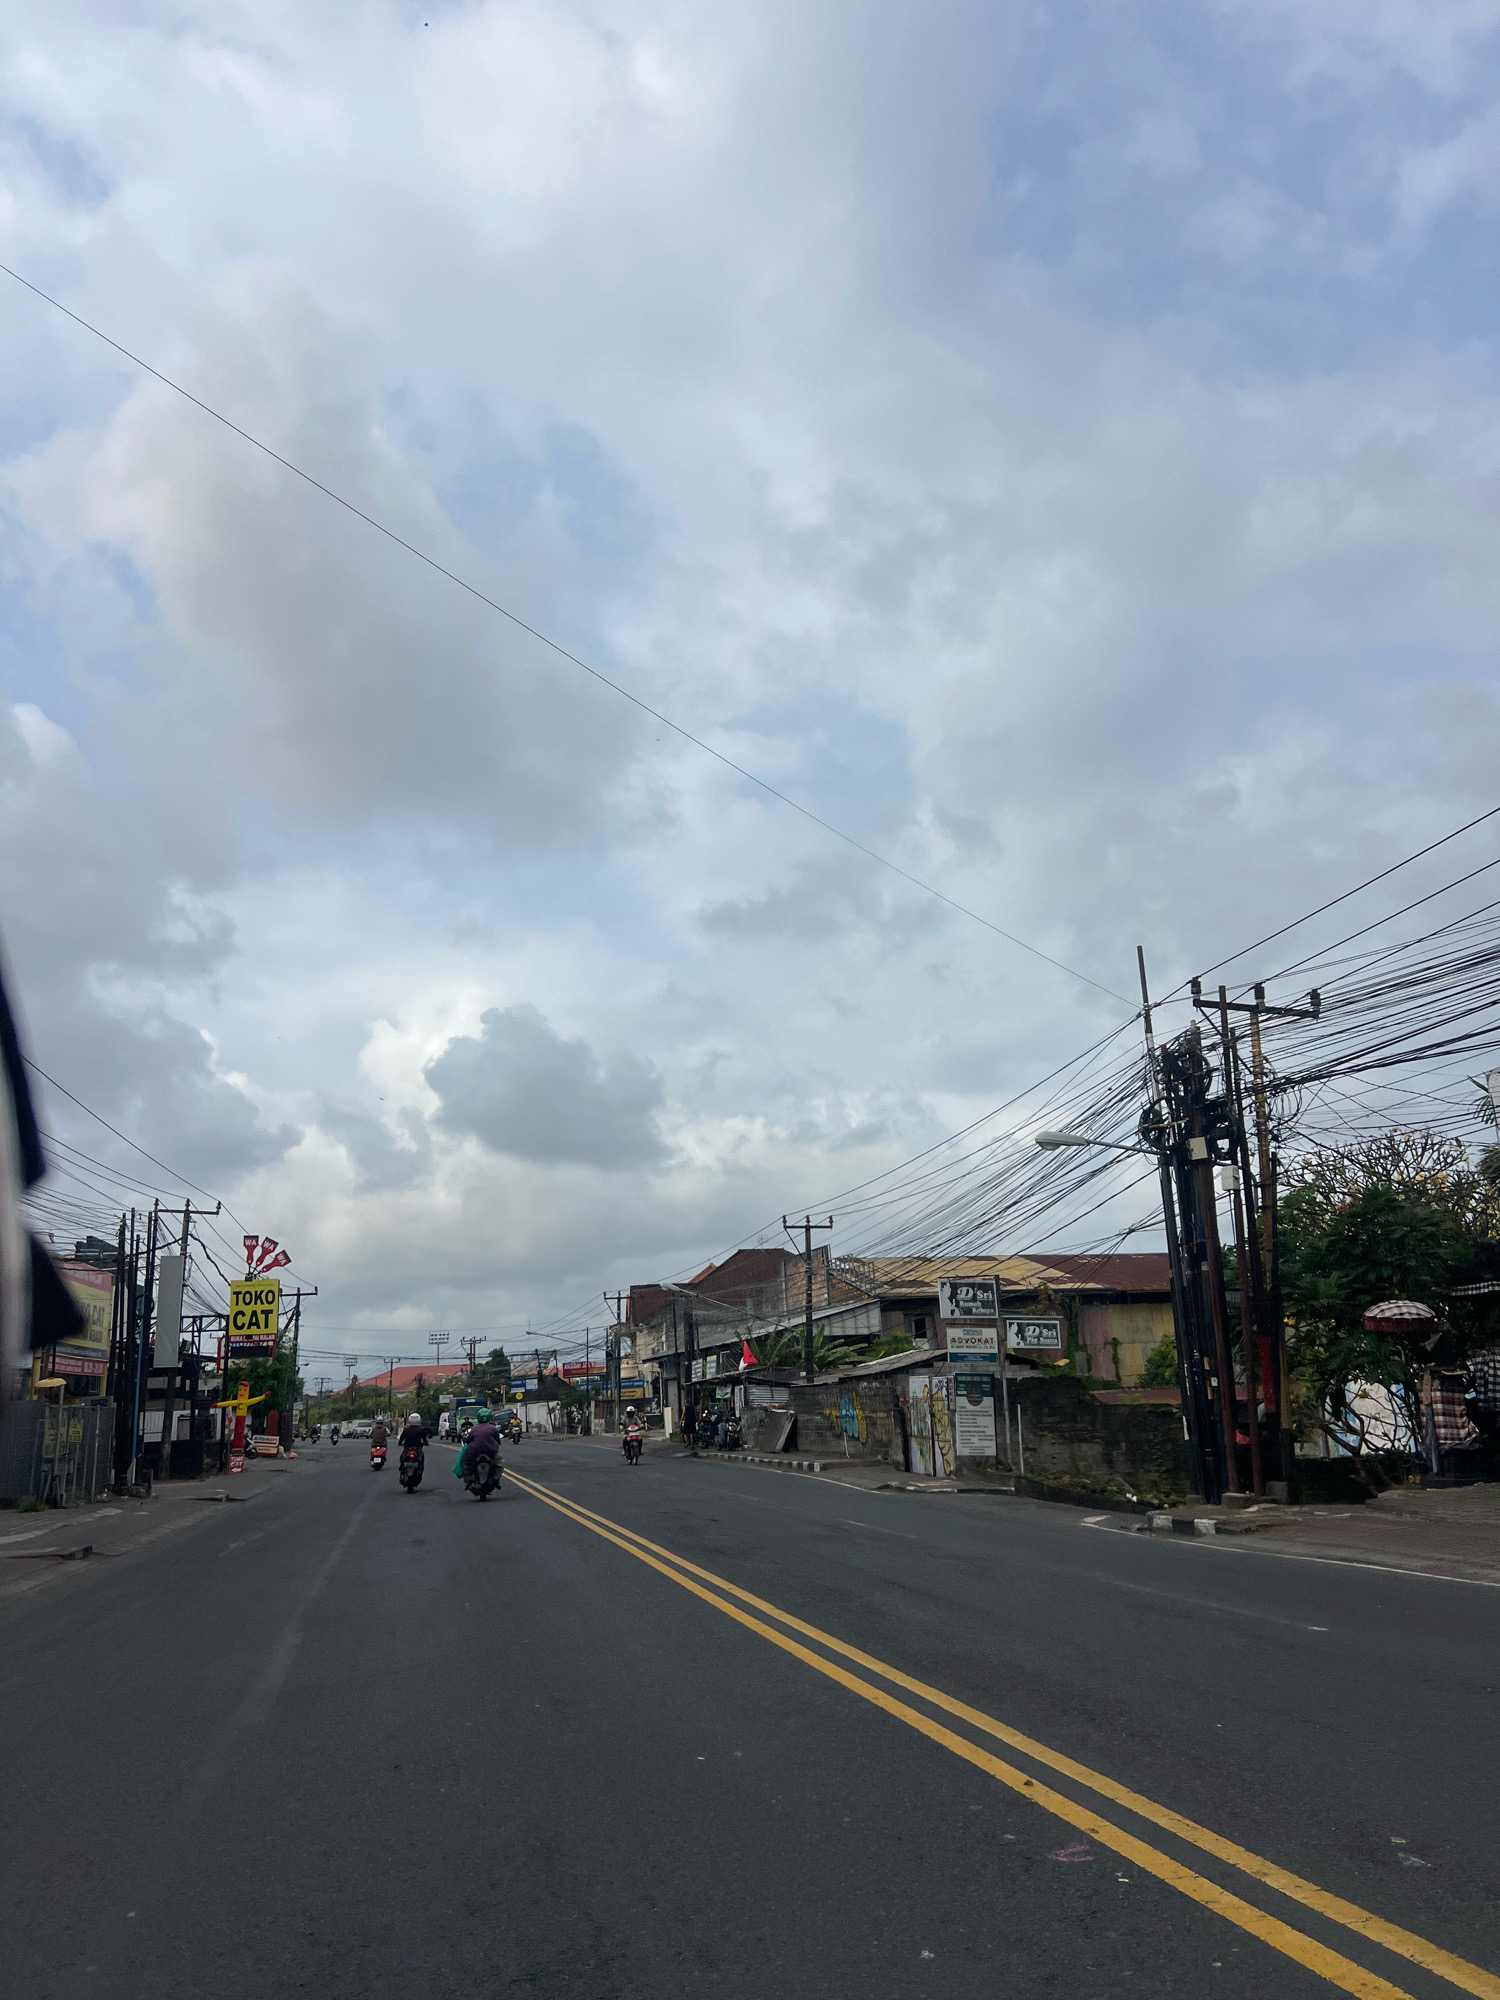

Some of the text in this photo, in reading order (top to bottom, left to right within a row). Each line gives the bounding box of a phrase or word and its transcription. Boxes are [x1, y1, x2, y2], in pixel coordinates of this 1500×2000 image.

[244, 1239, 257, 1247] WA
[263, 1240, 274, 1251] WA
[276, 1253, 287, 1265] WA
[233, 1289, 276, 1306] TOKO
[956, 1286, 993, 1301] D'Sri
[232, 1309, 274, 1331] CAT
[1024, 1325, 1056, 1337] D'Sri
[950, 1337, 994, 1345] ADVOKAT
[253, 1435, 278, 1443] Alfamart
